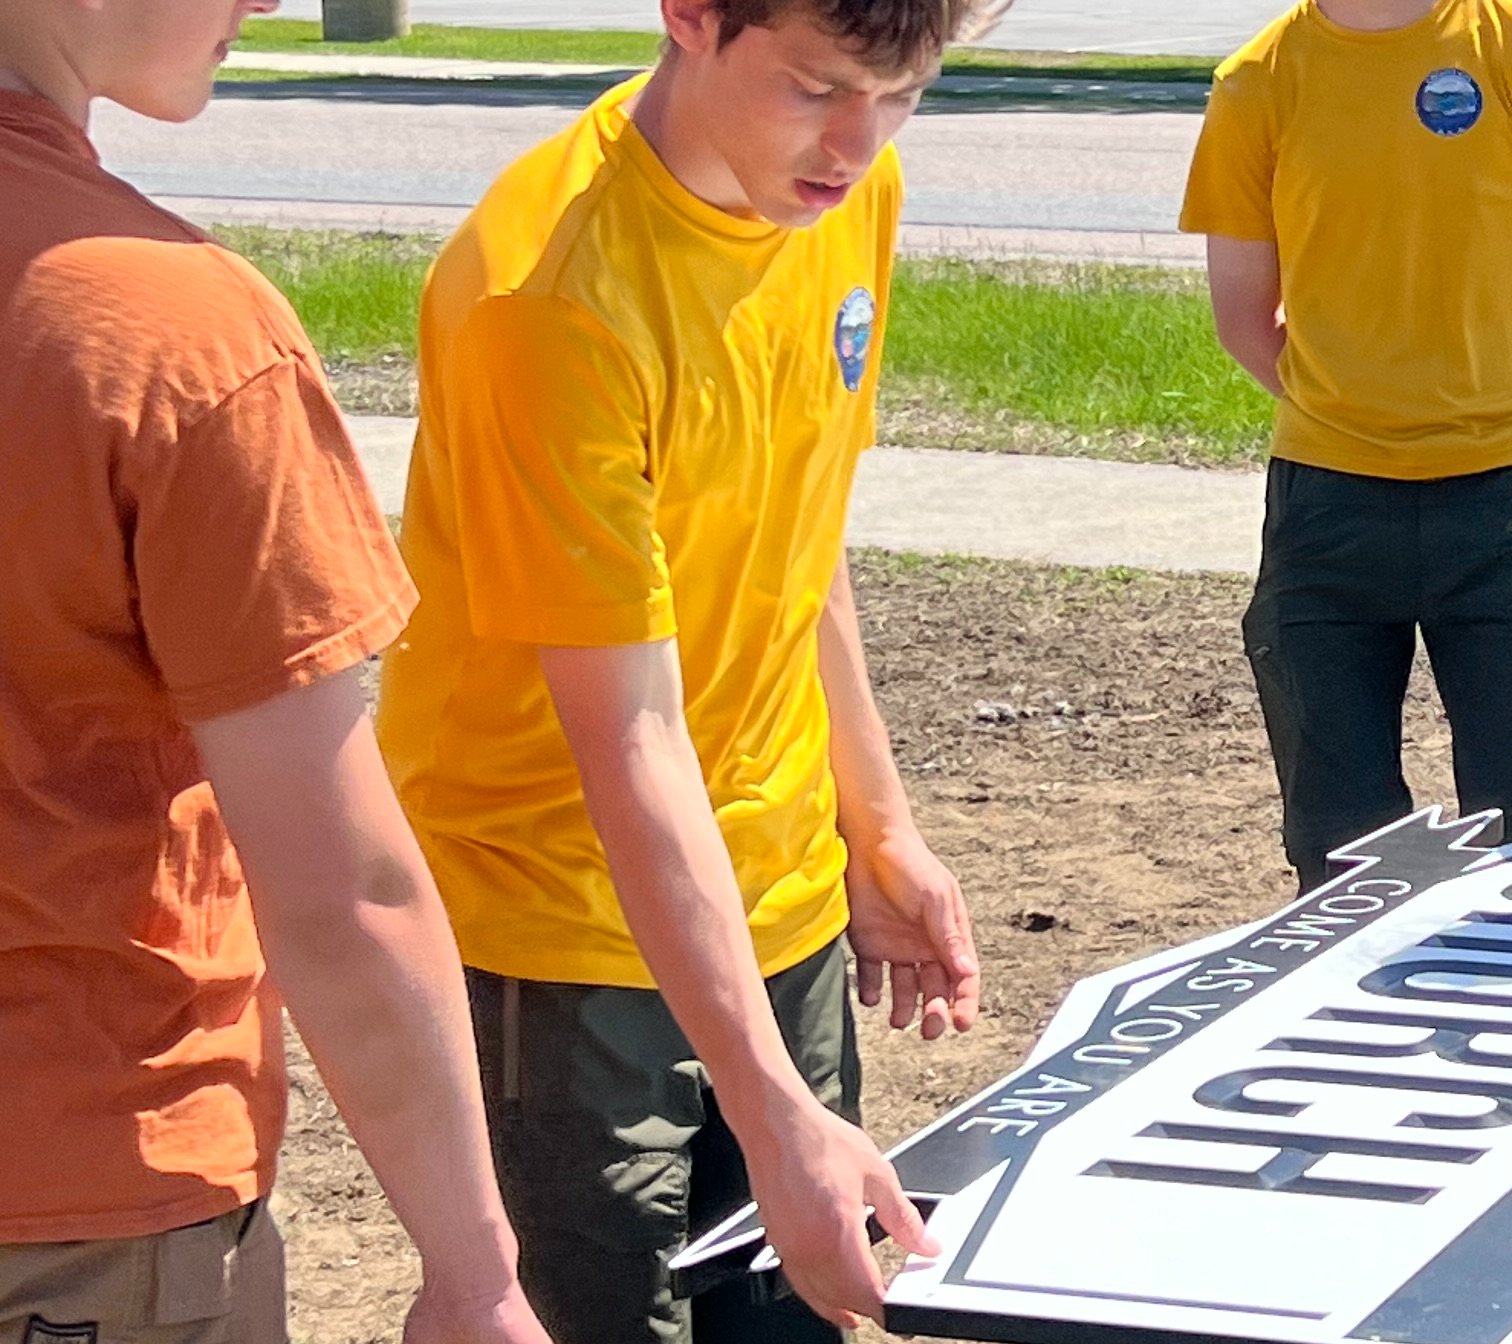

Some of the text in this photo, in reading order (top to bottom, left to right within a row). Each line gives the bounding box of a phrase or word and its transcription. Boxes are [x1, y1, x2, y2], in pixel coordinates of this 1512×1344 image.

[956, 878, 1413, 1137] COME AS YOU ARE
